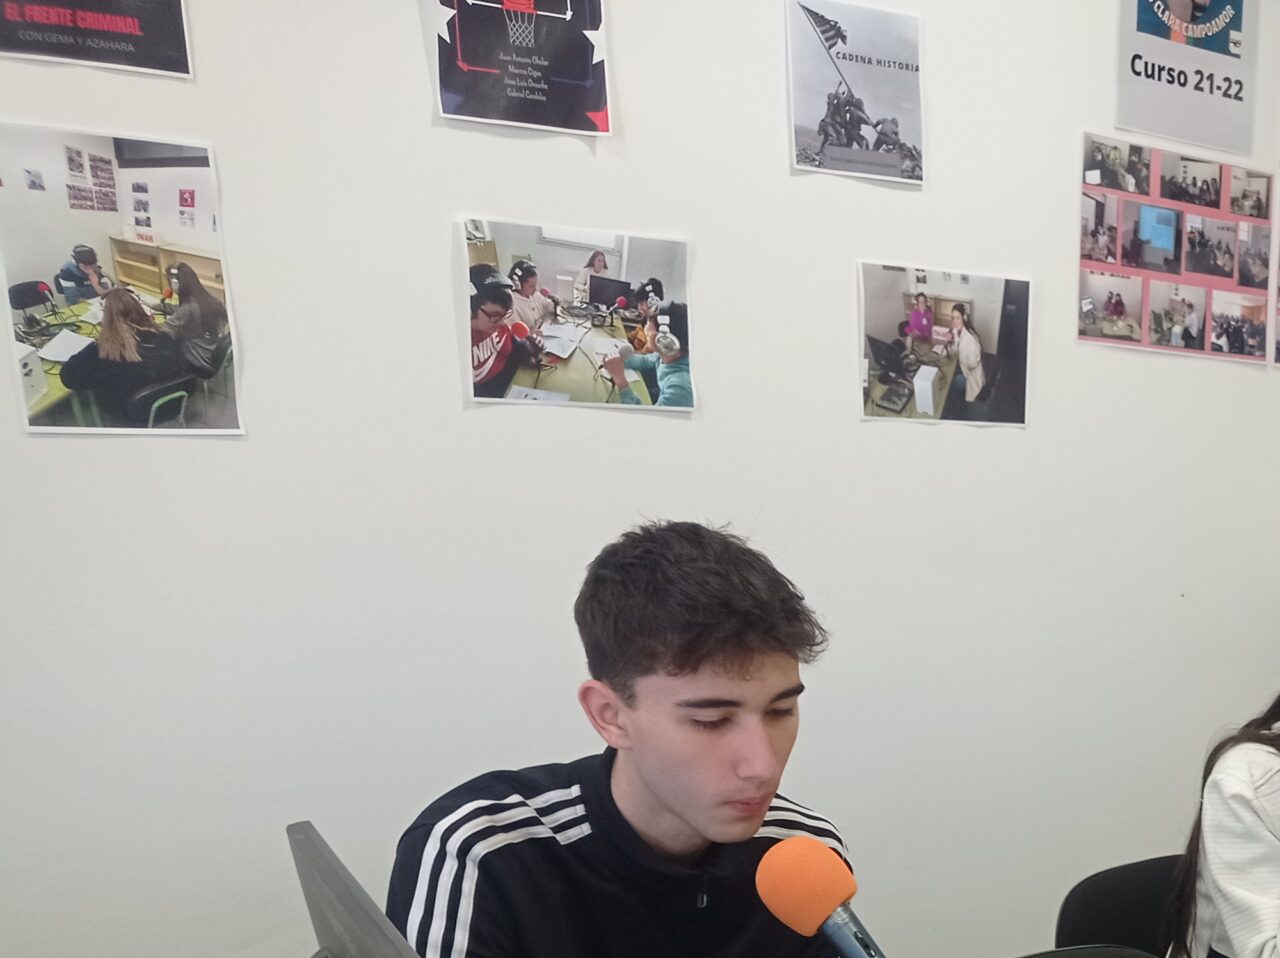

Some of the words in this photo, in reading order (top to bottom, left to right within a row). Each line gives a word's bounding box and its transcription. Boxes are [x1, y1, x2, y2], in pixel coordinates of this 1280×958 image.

[24, 4, 74, 27] FRENTE
[75, 9, 144, 36] CRIMINAL
[1153, 1, 1180, 33] CLARA
[1182, 4, 1236, 38] CAMPOAMOR
[18, 30, 43, 41] CON
[86, 38, 136, 52] AZAHARA
[835, 51, 873, 65] CADENA
[876, 58, 920, 73] HISTORIA
[1130, 53, 1188, 88] Curso
[1193, 69, 1244, 102] 21-22
[472, 331, 501, 367] NIKE
